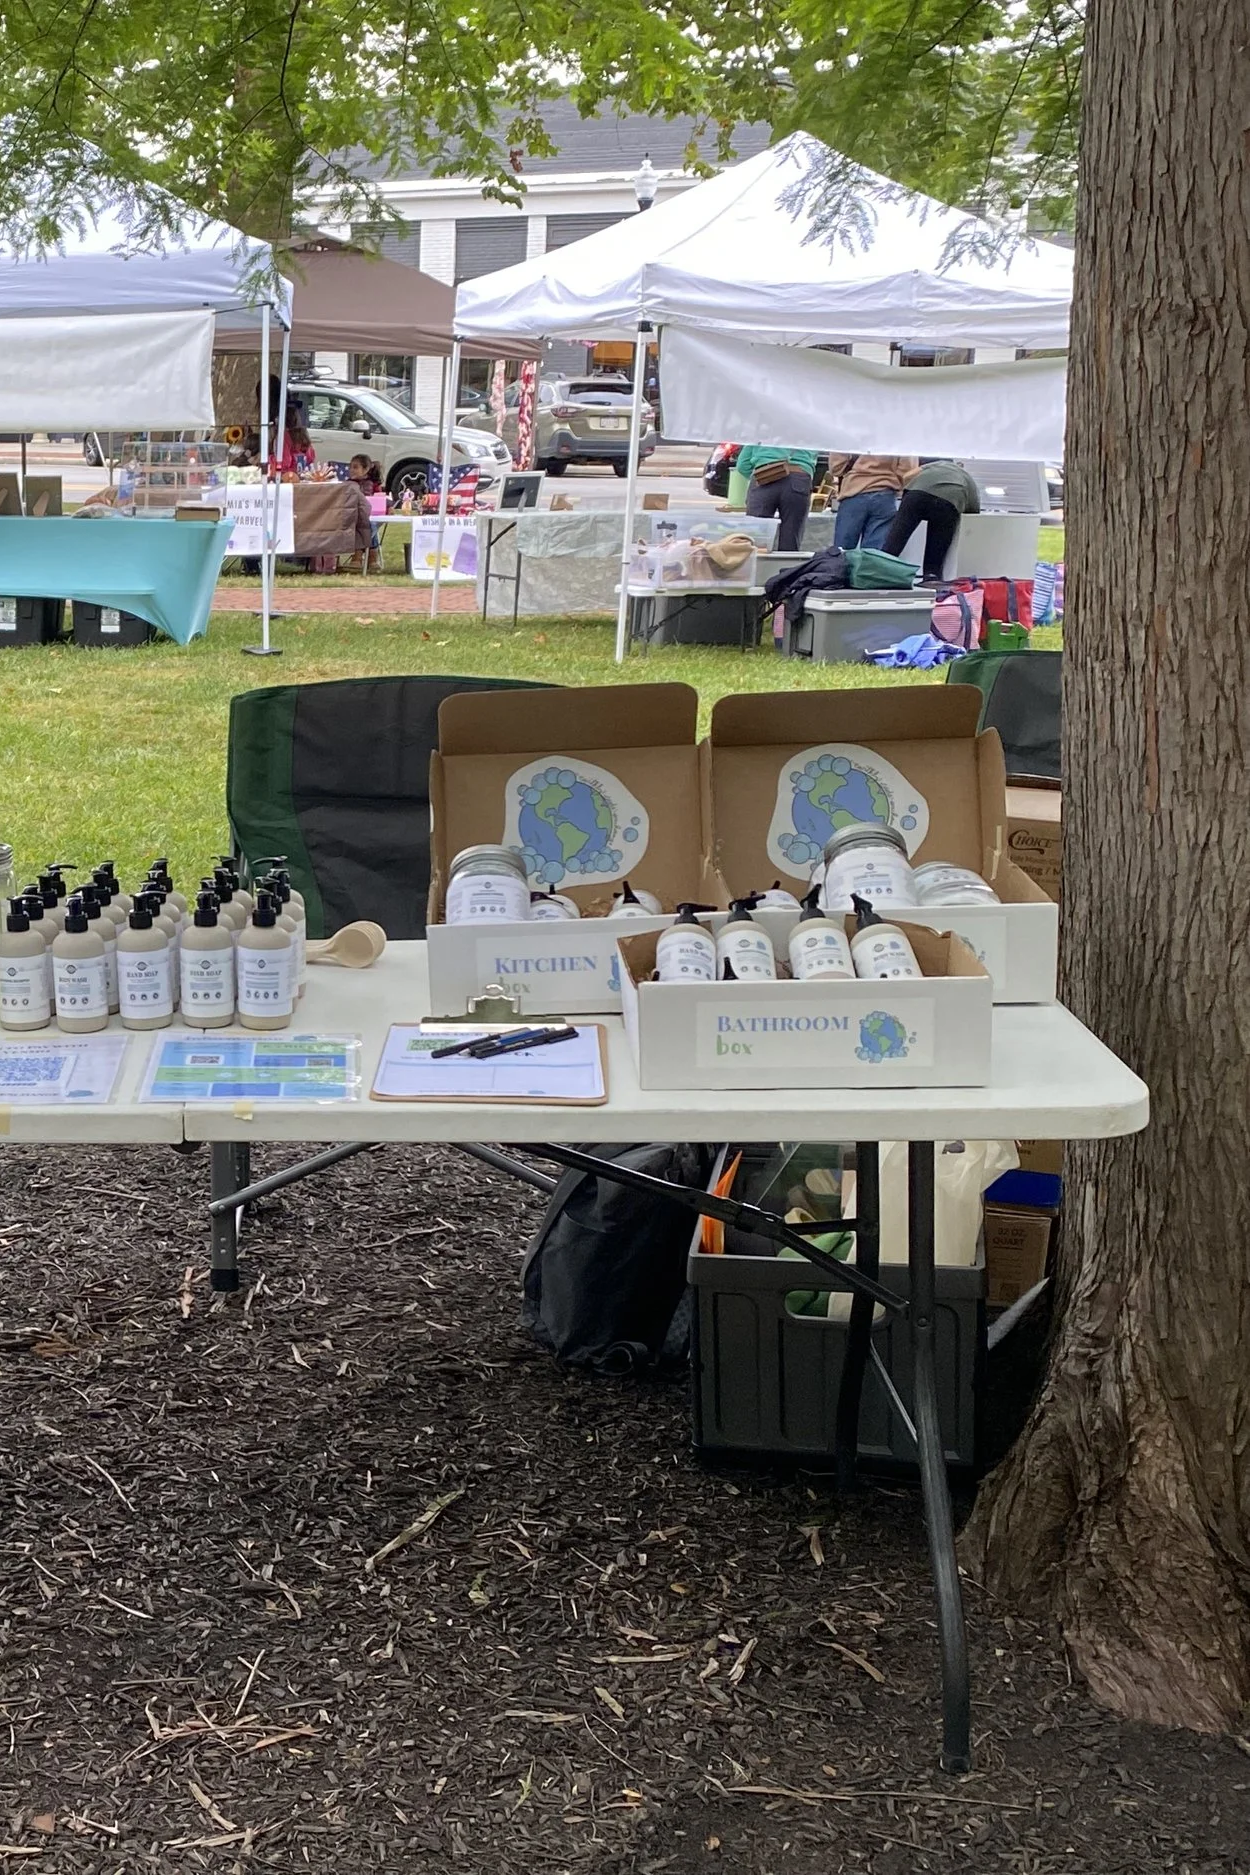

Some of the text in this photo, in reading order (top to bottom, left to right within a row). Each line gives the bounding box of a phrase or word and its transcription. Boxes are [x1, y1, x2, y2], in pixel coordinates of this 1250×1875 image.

[1008, 829, 1056, 855] CHOICE
[494, 955, 598, 974] KITCHEN
[717, 1016, 850, 1032] BATHROOM
[716, 1034, 754, 1056] box
[993, 1236, 1024, 1246] QUART
